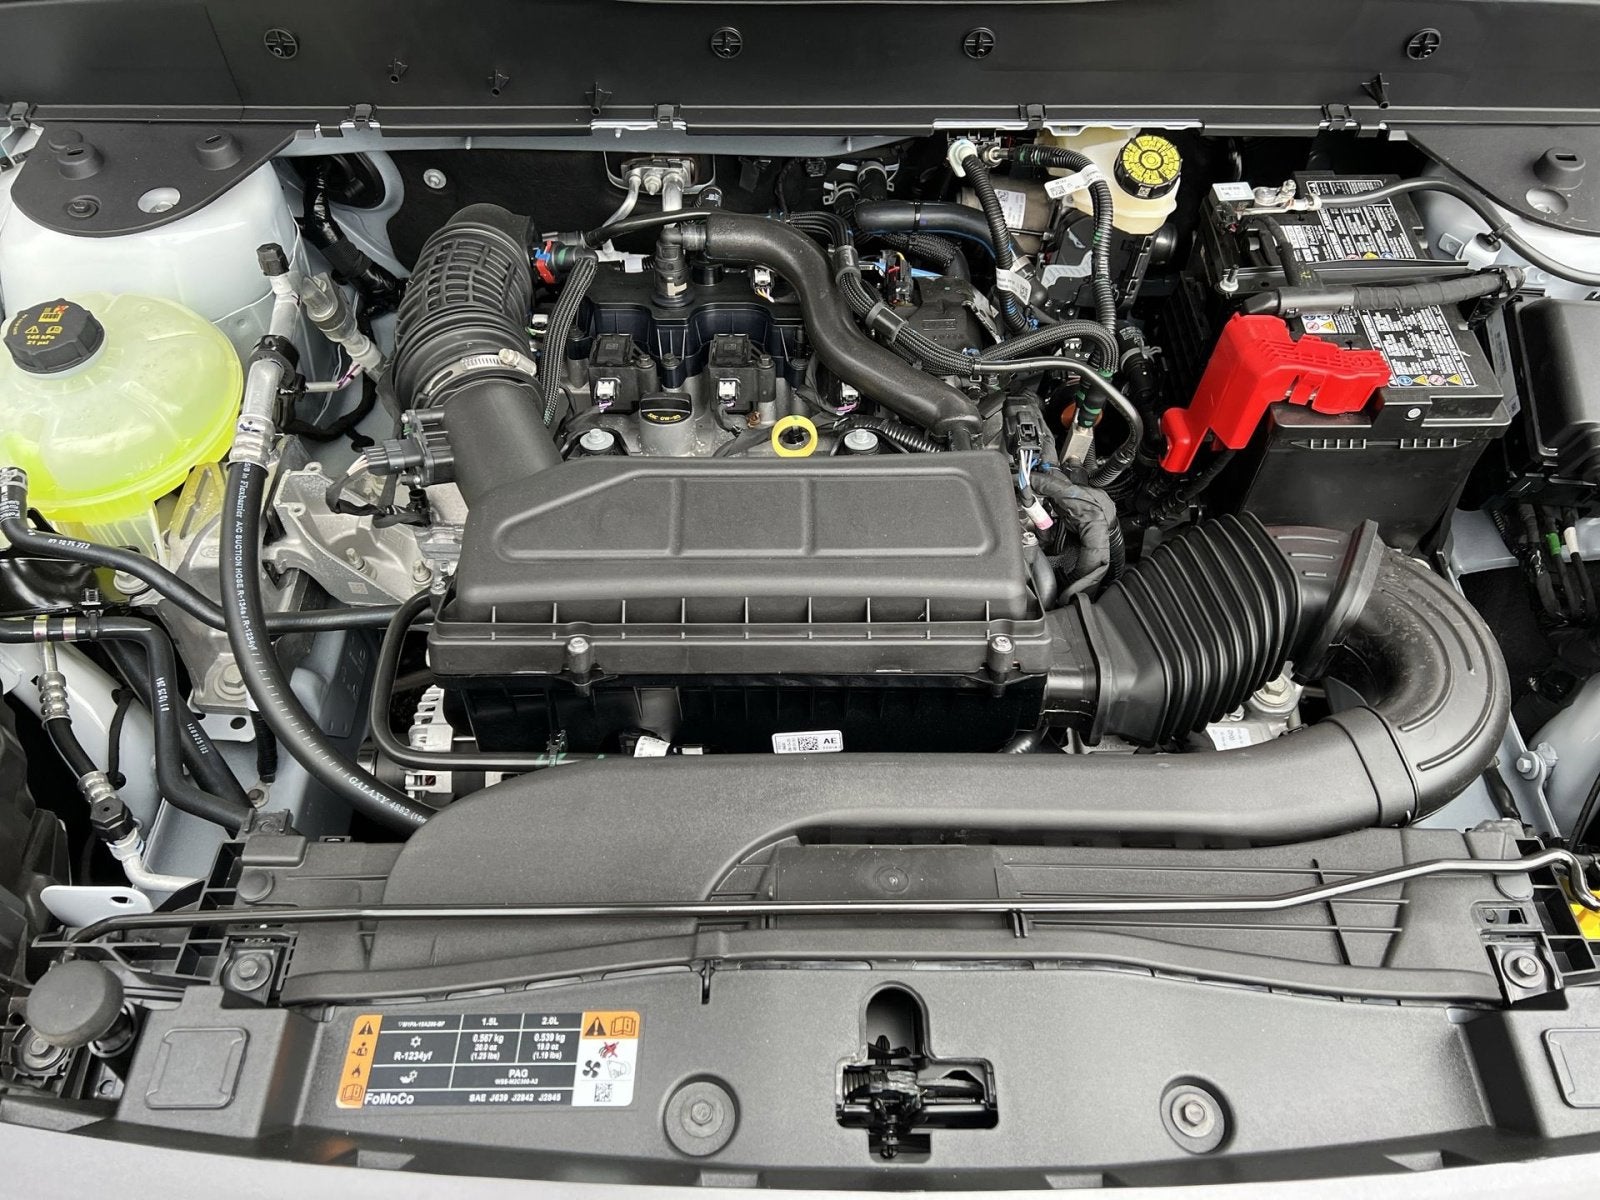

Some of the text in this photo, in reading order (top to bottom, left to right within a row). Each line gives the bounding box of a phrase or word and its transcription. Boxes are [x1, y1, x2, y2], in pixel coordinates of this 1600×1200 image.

[235, 480, 249, 518] Flexbarrier
[235, 521, 243, 534] A/C
[234, 534, 243, 567] SUCTION
[235, 567, 244, 589] HOSE
[236, 589, 247, 615] R-134a
[243, 619, 258, 651] R-1234yf
[348, 776, 391, 804] GALAXY
[389, 801, 410, 816] 4882
[481, 1017, 499, 1026] 1.5L
[541, 1016, 559, 1026] 2.0L
[472, 1033, 504, 1045] 0.567 kg
[533, 1032, 566, 1044] 0.539 kg
[393, 1050, 433, 1063] R-1234yf
[508, 1068, 529, 1079] PAG
[364, 1092, 415, 1105] FoMoCo
[469, 1093, 487, 1103] SAE
